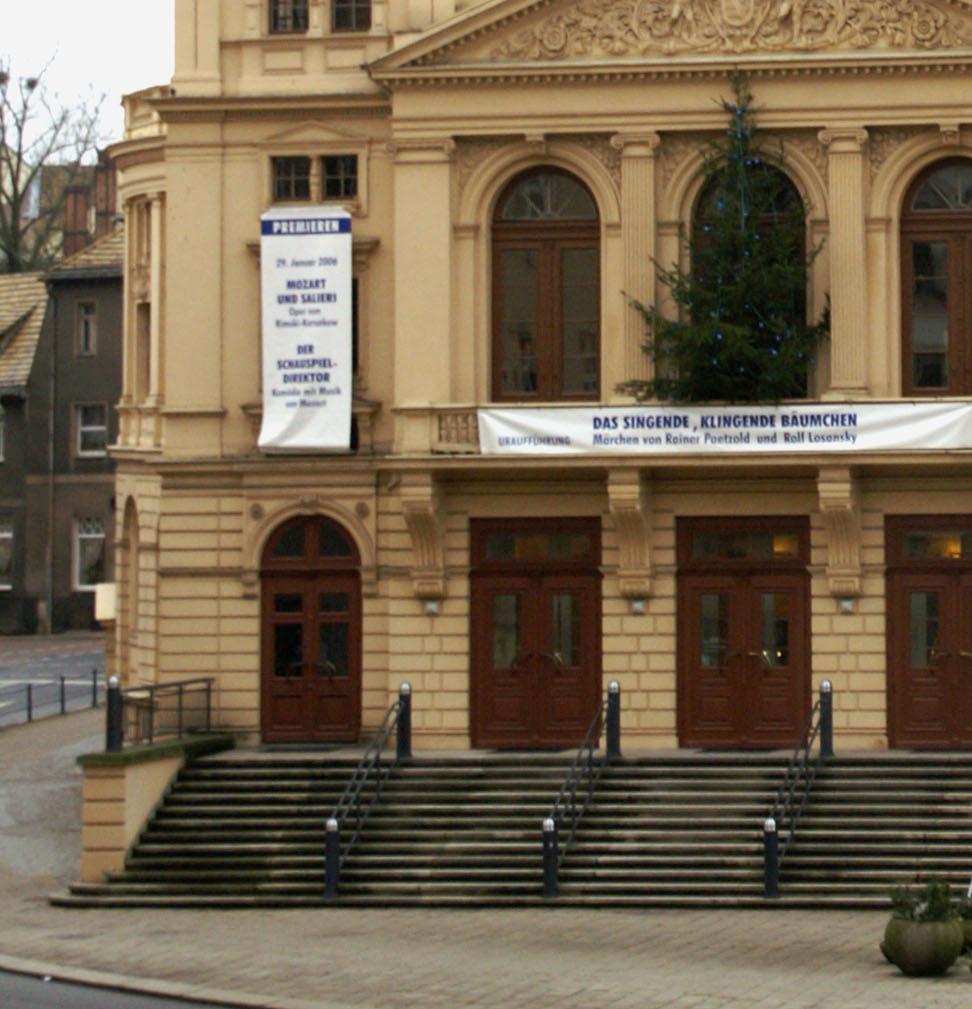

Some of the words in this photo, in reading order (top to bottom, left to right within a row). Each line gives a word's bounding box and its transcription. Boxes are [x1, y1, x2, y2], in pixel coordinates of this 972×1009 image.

[272, 220, 340, 234] PREMIEREN
[291, 257, 316, 267] Januar
[318, 256, 338, 266] 2006
[286, 279, 327, 290] MOZART
[277, 294, 298, 304] UND
[301, 292, 337, 303] SALIERI
[297, 345, 315, 355] DER
[277, 358, 338, 370] SCHAUSPIEL-
[283, 373, 331, 384] DIREKTOR
[592, 415, 618, 429] DAS
[700, 414, 776, 428] KLINGENDE
[781, 411, 858, 428] BÄUMCHEN
[498, 434, 571, 447] URAUFFÜHRUNG
[593, 433, 639, 445] Märchen
[642, 435, 662, 445] von
[665, 433, 700, 445] Rainer
[757, 433, 777, 444] und
[784, 431, 805, 443] Rolf
